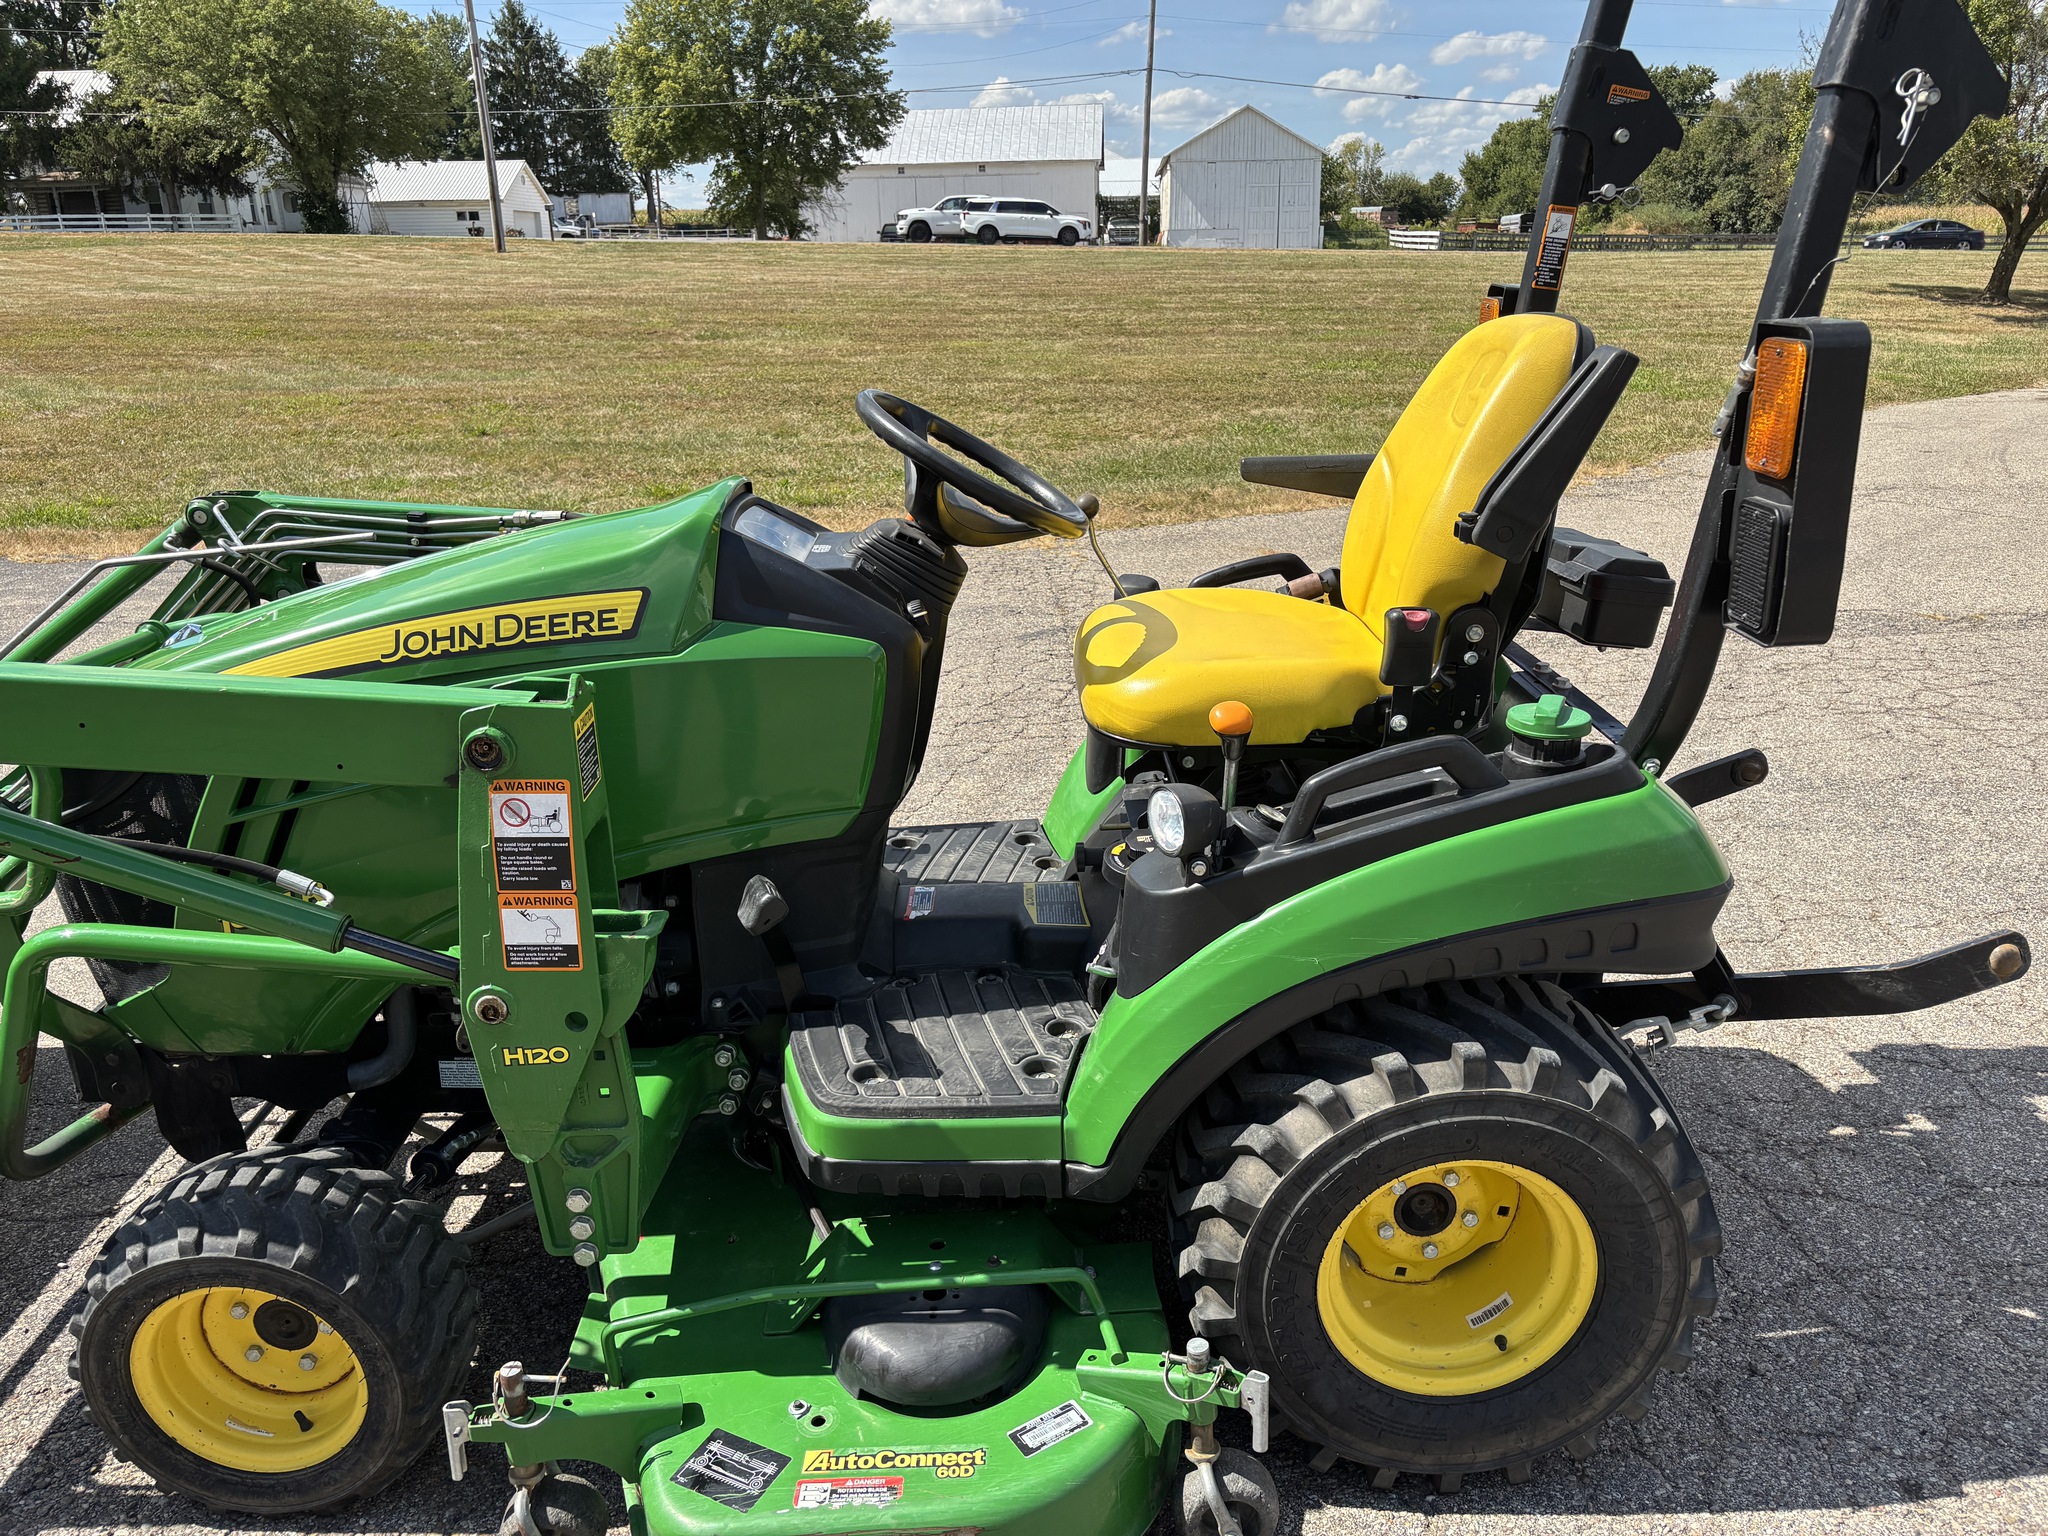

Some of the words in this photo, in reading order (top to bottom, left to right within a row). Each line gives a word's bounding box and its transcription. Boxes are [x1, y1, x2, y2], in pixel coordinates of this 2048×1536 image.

[1619, 87, 1648, 98] WARNING
[380, 622, 483, 660] JOHN
[494, 608, 619, 643] DEERE
[503, 781, 566, 791] WARNING
[513, 896, 573, 906] WARNING
[502, 1046, 570, 1066] H120
[804, 1447, 986, 1471] AutoConnect
[936, 1465, 975, 1479] 60D
[854, 1478, 886, 1486] DANGER
